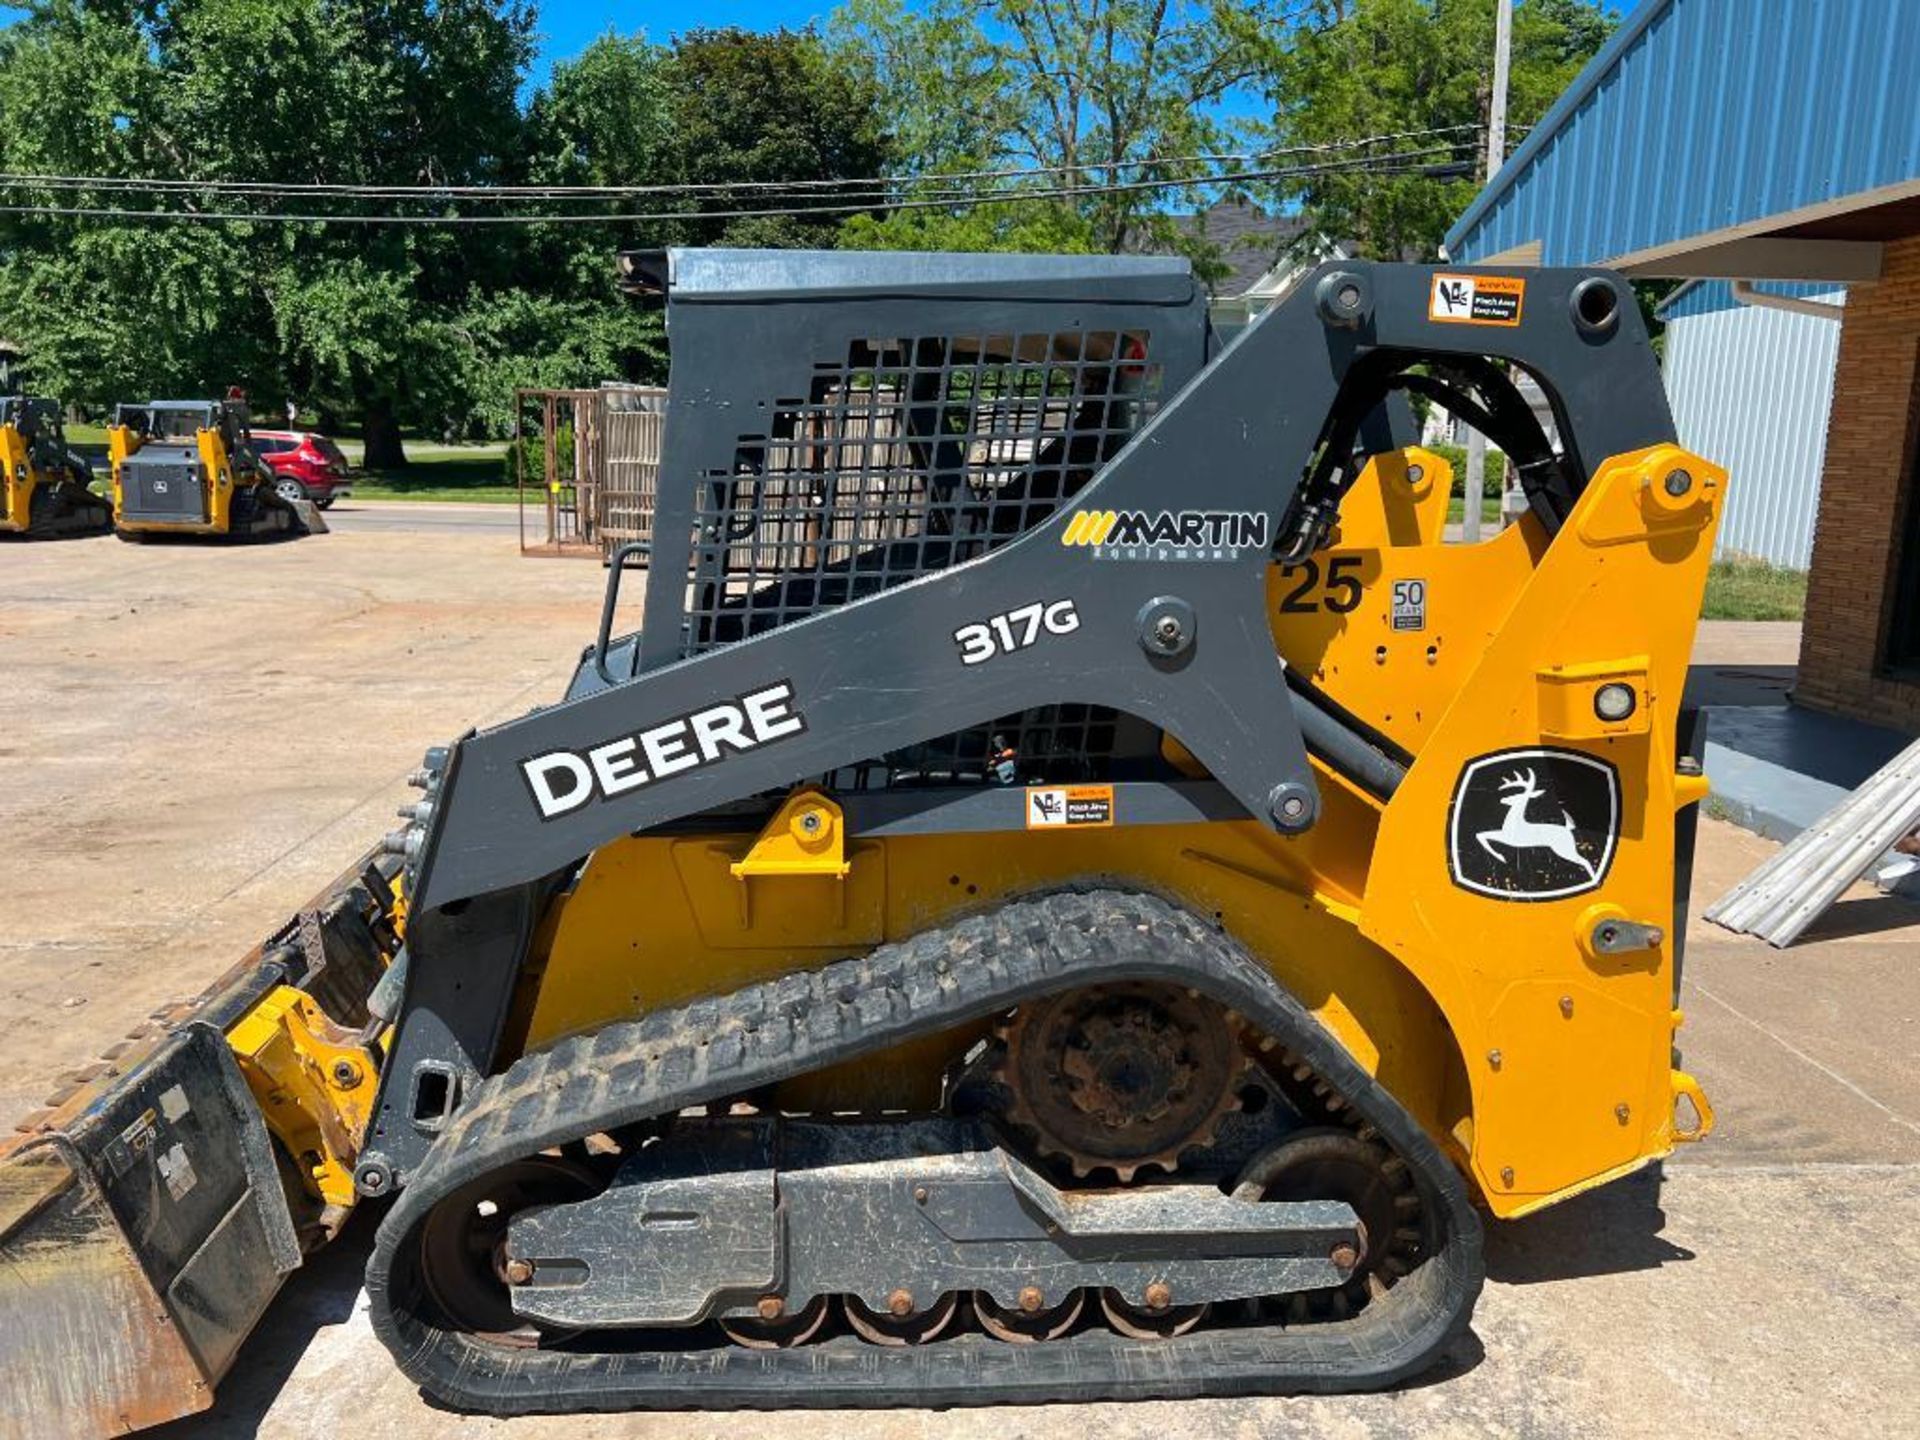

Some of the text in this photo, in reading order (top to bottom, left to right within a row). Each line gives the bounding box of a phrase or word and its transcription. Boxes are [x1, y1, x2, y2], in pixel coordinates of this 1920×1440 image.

[1105, 510, 1269, 548] MARTIN
[1268, 556, 1363, 614] 25
[1394, 582, 1423, 606] 50
[954, 599, 1081, 665] 317G
[522, 683, 804, 818] DEERE
